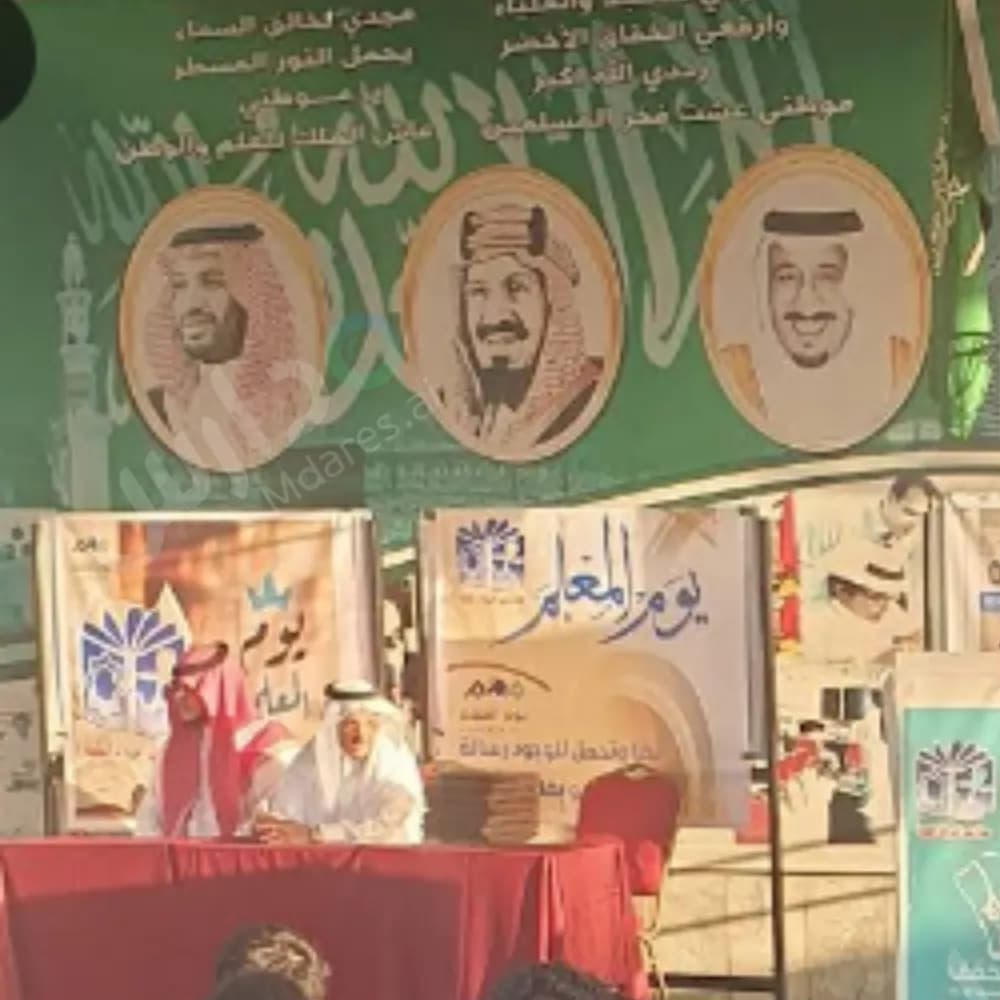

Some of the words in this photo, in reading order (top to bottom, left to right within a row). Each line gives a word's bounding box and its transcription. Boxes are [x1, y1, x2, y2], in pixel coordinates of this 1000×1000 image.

[263, 10, 334, 38] لخالق
[342, 8, 416, 38] مجدي
[597, 20, 687, 51] الخفاق
[696, 16, 790, 48] وارفعي
[276, 47, 333, 76] النور
[338, 46, 413, 70] يحمل
[622, 107, 671, 134] فخر
[678, 99, 751, 123] عشت
[758, 93, 855, 127] موطني
[490, 513, 634, 648] المعلم
[597, 568, 709, 645] يوم
